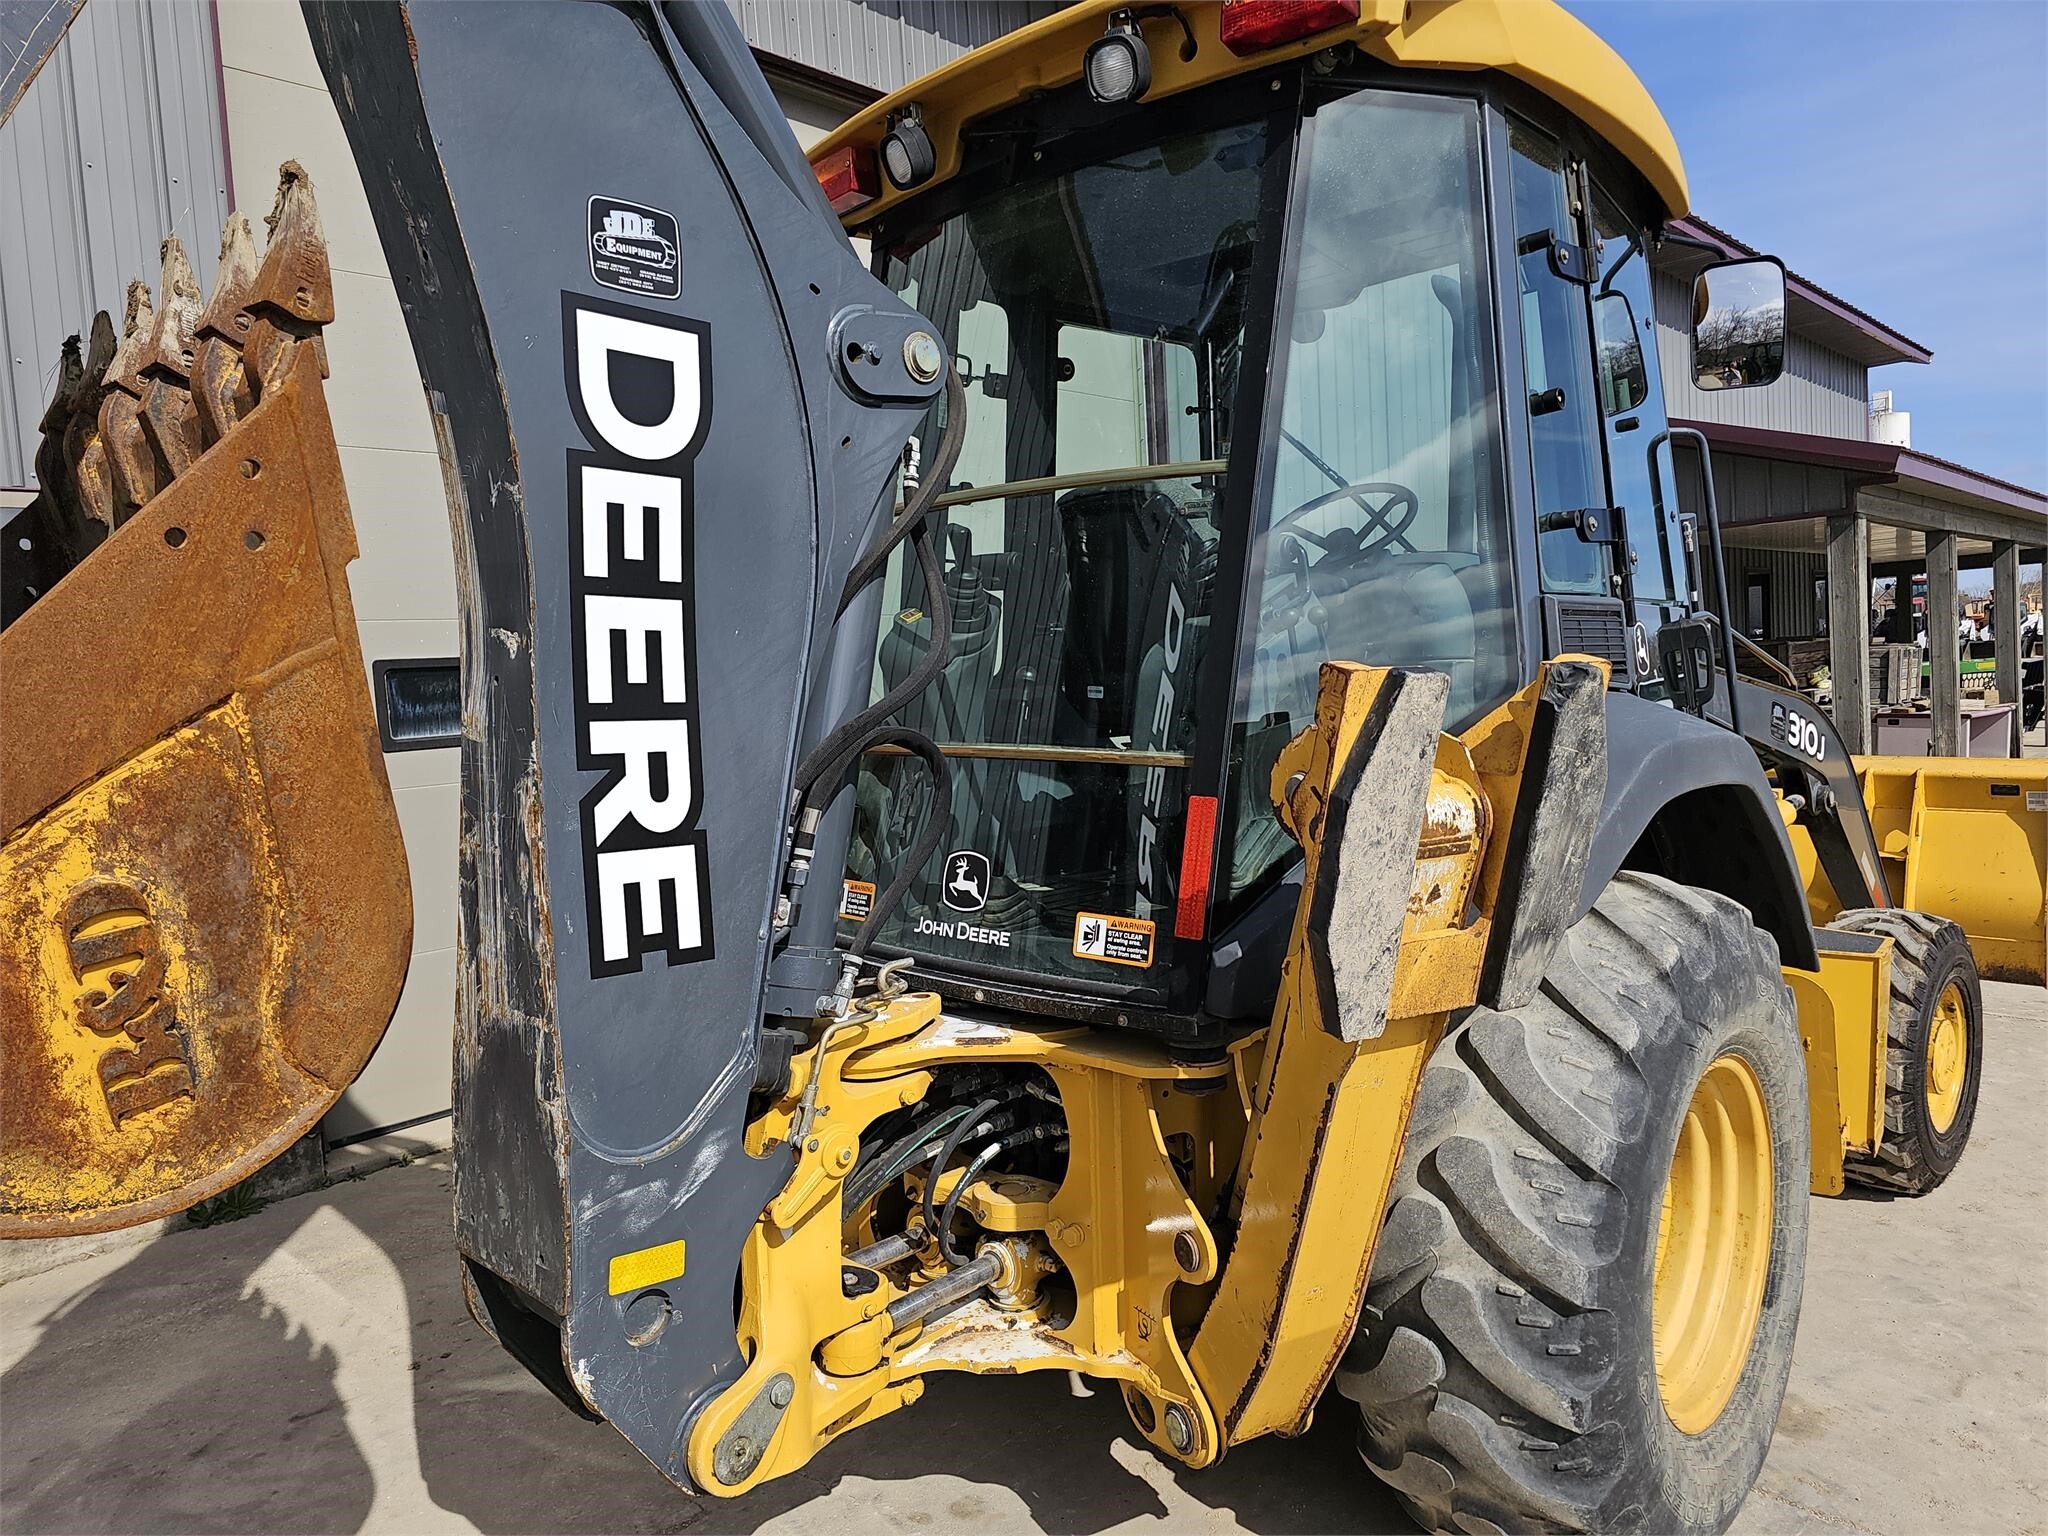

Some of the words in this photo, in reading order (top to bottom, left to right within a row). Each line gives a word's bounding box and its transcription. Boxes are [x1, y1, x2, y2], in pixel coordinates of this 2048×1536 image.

[606, 237, 663, 261] EQUIPMENT
[576, 308, 702, 962] DEERE
[1788, 711, 1826, 761] 310J
[913, 916, 955, 938] JOHN
[956, 922, 1011, 947] DEERE
[1117, 920, 1152, 932] WARNING
[1123, 932, 1143, 941] CLEAR
[1106, 944, 1126, 952] Operate
[1126, 947, 1148, 955] controls
